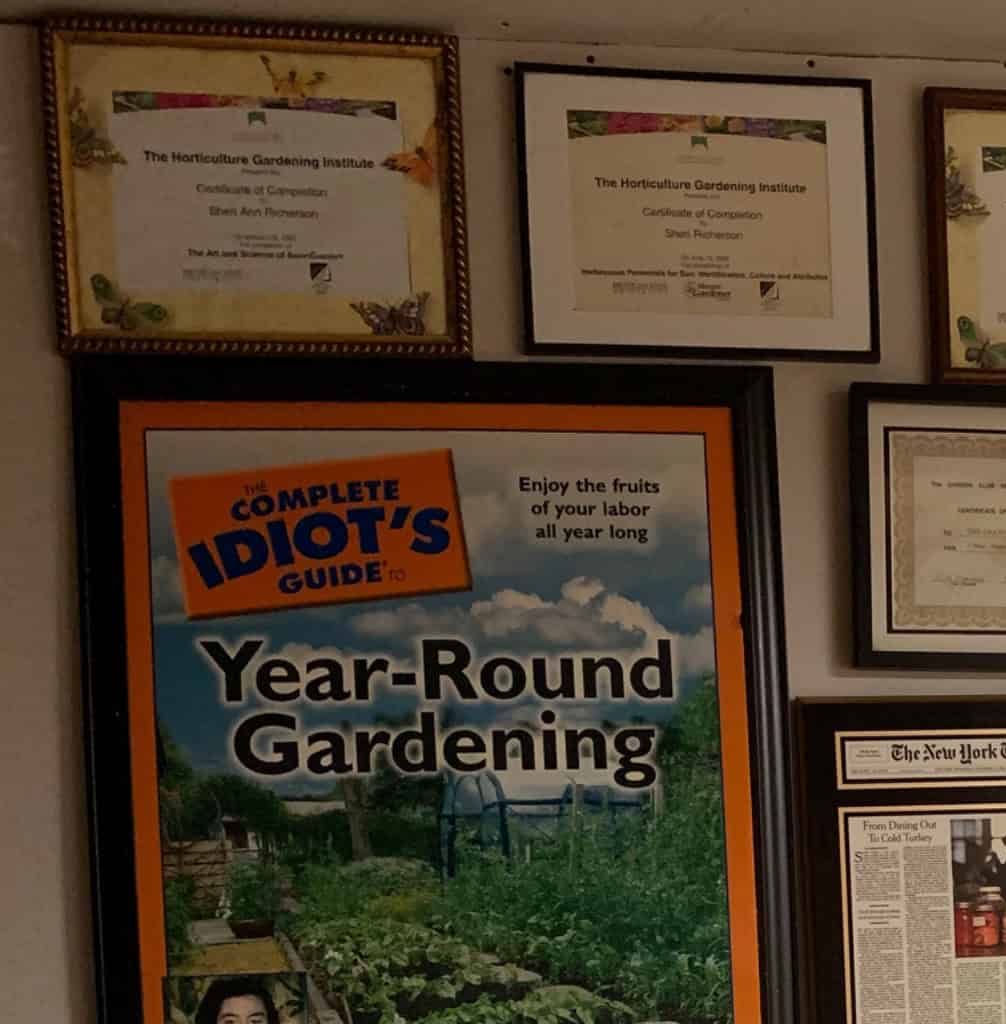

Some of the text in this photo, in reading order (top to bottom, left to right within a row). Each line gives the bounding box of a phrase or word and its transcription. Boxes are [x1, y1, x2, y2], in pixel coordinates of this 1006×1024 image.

[144, 151, 375, 169] The Horticulture Gardening Institute
[594, 177, 807, 194] The Horticulture Gardening Institute
[519, 476, 661, 498] Enjoy the fruits
[230, 478, 401, 521] COMPLETE
[531, 499, 650, 522] of your labor
[535, 523, 649, 545] all year long
[187, 506, 451, 590] IDIOT'S
[200, 637, 674, 703] Year-Round
[233, 710, 657, 788] Gardening
[891, 744, 921, 762] The
[922, 745, 957, 761] New
[960, 744, 997, 765] York
[863, 819, 937, 833] From Dining Out
[869, 832, 933, 845] To Cold Turkey
